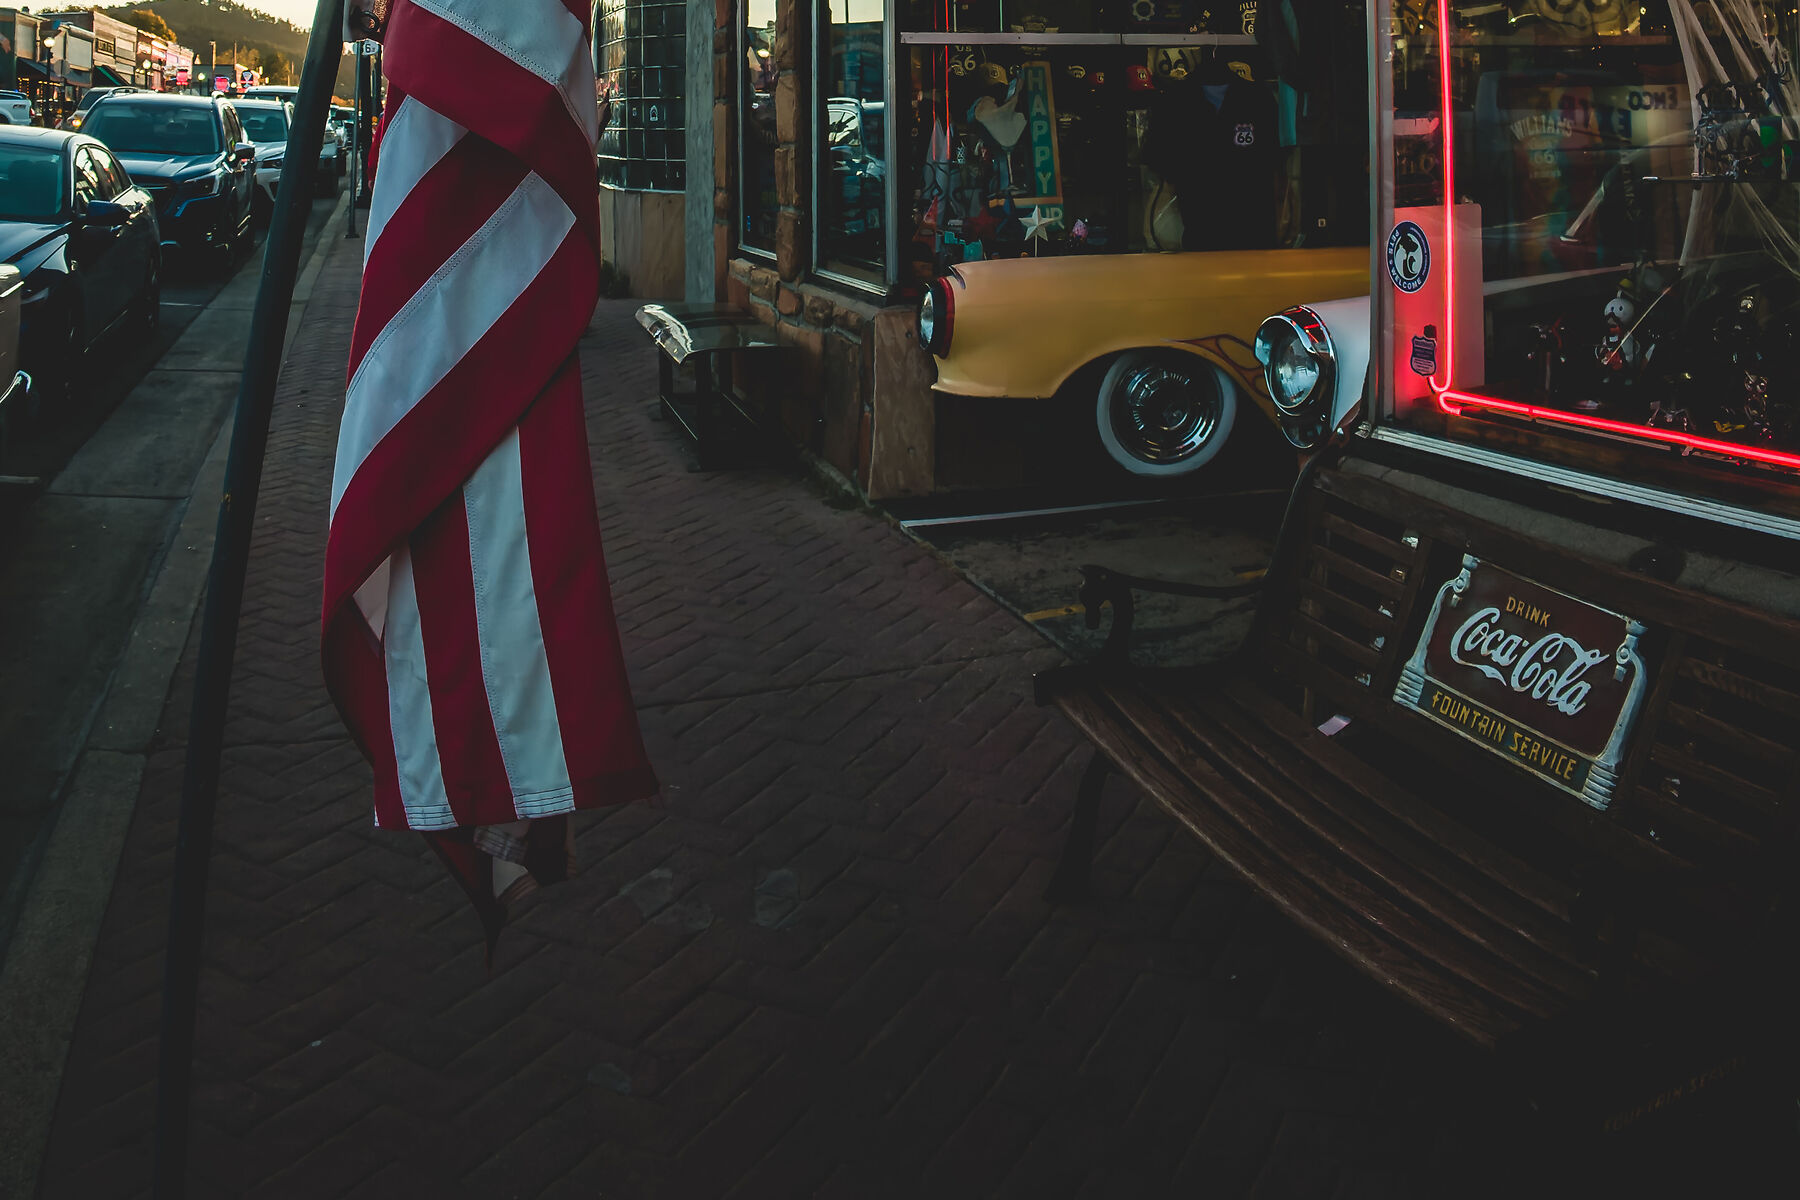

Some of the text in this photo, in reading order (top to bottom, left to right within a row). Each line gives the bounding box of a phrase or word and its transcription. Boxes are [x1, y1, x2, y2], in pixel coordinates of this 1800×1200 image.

[1027, 69, 1053, 195] HAPPY
[1237, 131, 1253, 144] 66
[1388, 229, 1400, 255] PETS
[1391, 266, 1423, 291] WELCOME
[1505, 596, 1552, 629] DRINK
[1449, 606, 1611, 717] Coca-Cola
[1431, 689, 1577, 781] FOUNTAIN SERVICE
